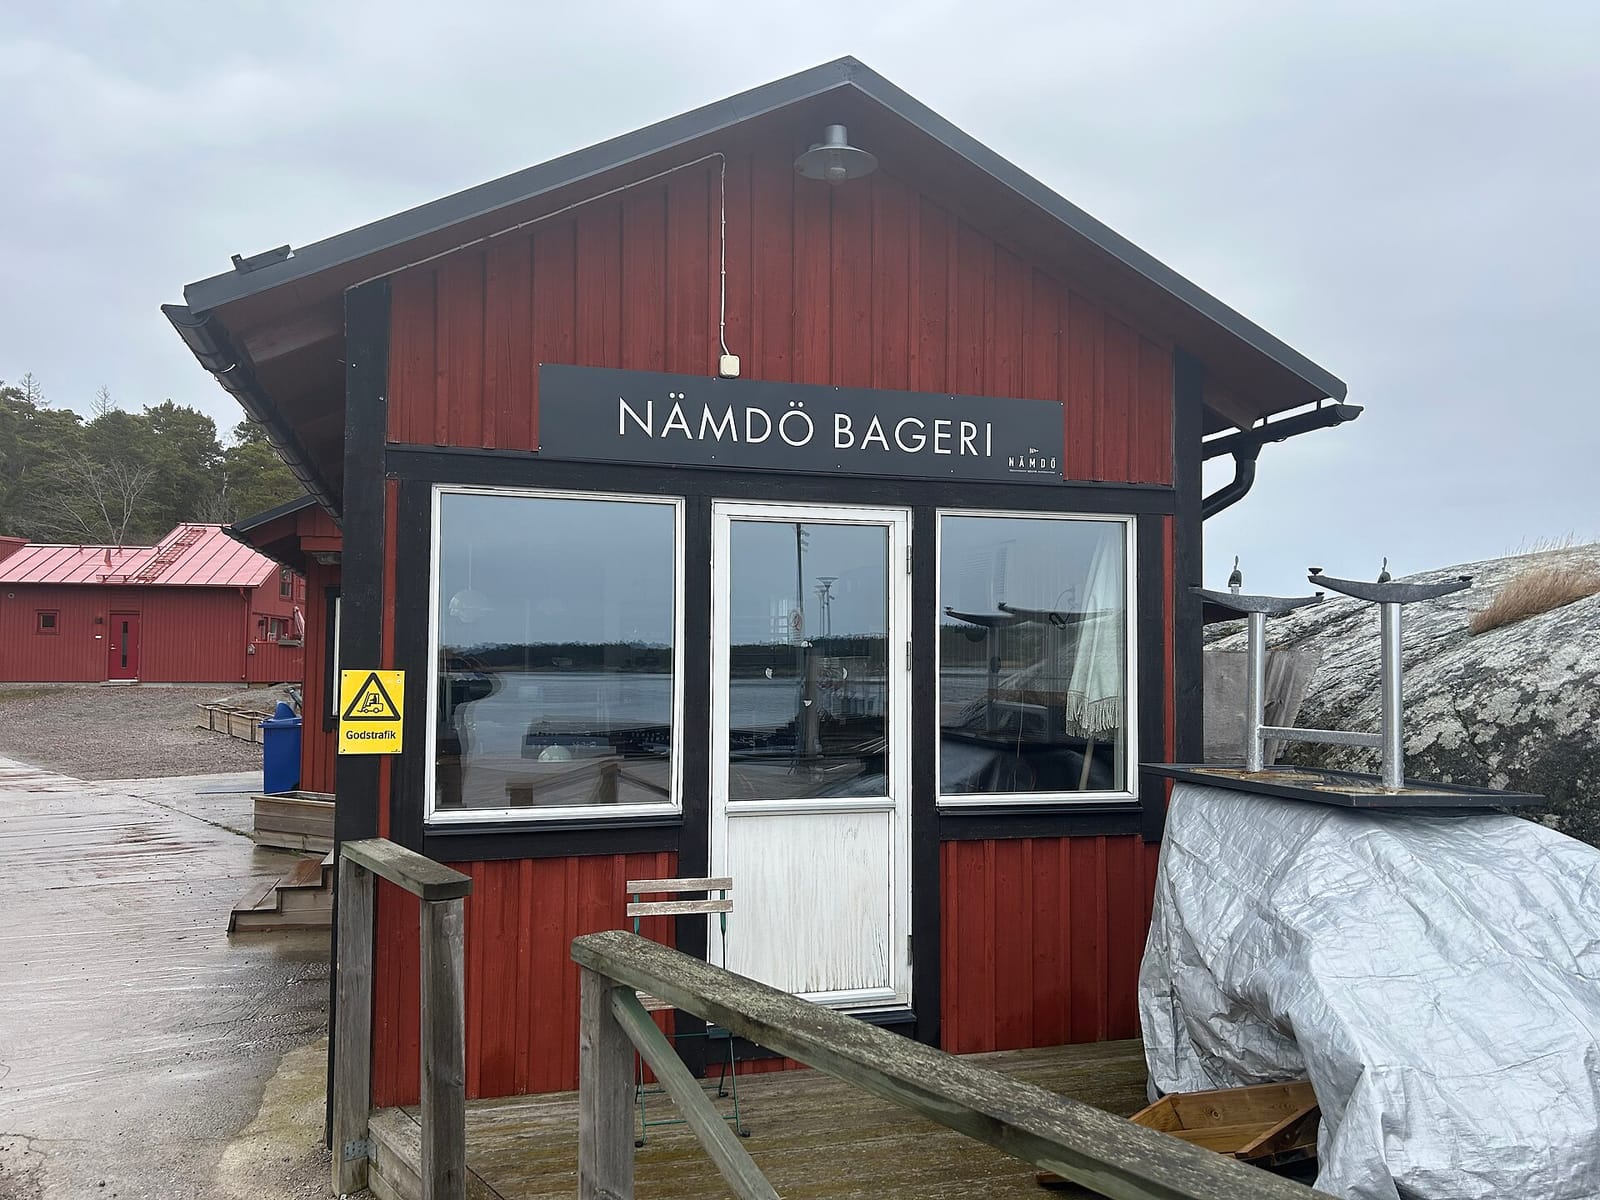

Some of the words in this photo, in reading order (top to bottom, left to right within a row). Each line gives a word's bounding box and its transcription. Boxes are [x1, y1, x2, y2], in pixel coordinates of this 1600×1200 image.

[618, 392, 815, 447] NÄMDÖ
[833, 413, 993, 457] BAGERI
[1008, 455, 1057, 469] NÄMDÖ
[346, 730, 396, 739] Godstrafik
